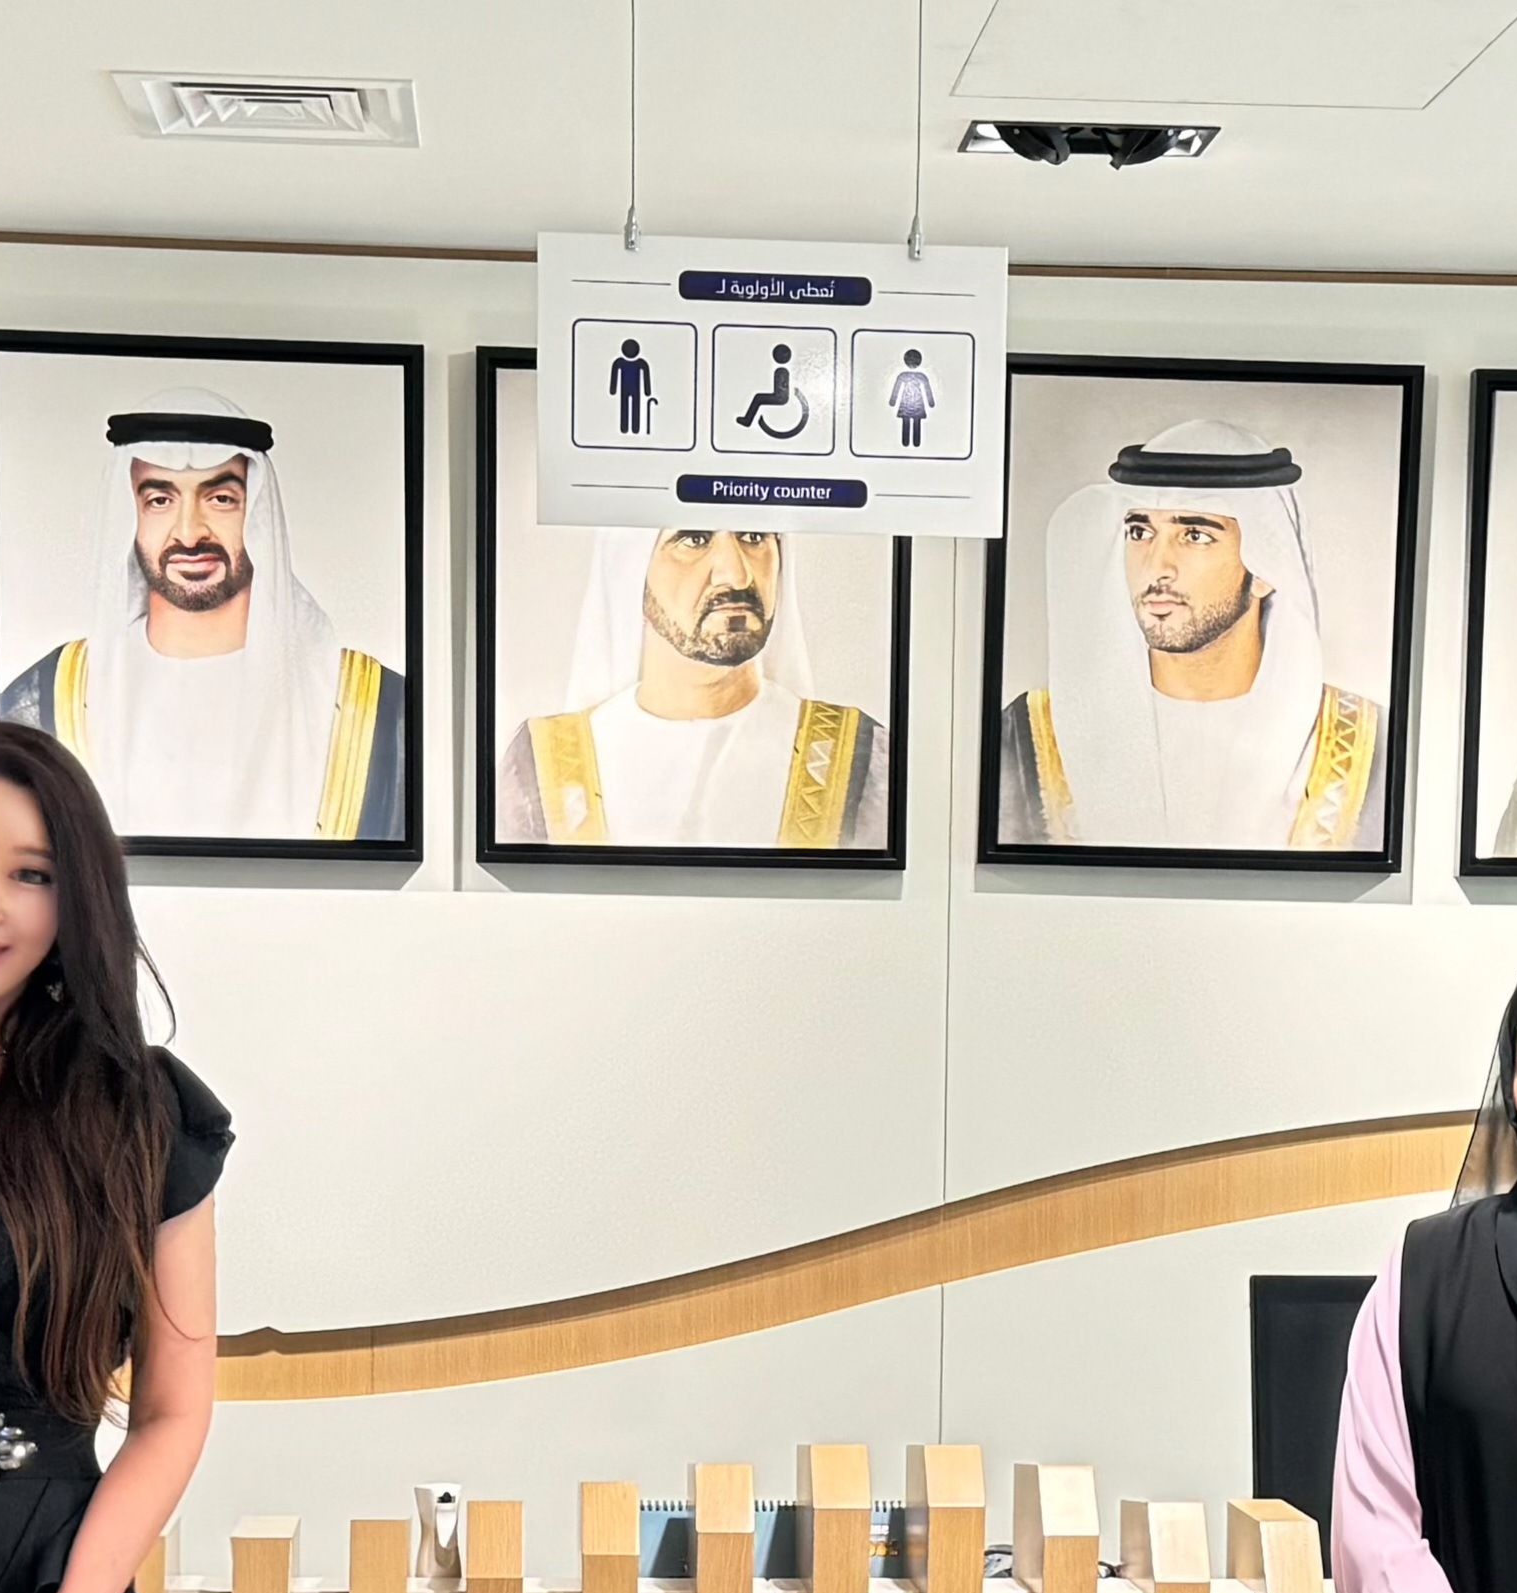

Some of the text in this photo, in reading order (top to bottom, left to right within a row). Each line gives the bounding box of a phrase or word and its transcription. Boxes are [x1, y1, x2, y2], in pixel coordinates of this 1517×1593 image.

[730, 277, 784, 300] الأولوية
[712, 480, 832, 501] Priority counter
